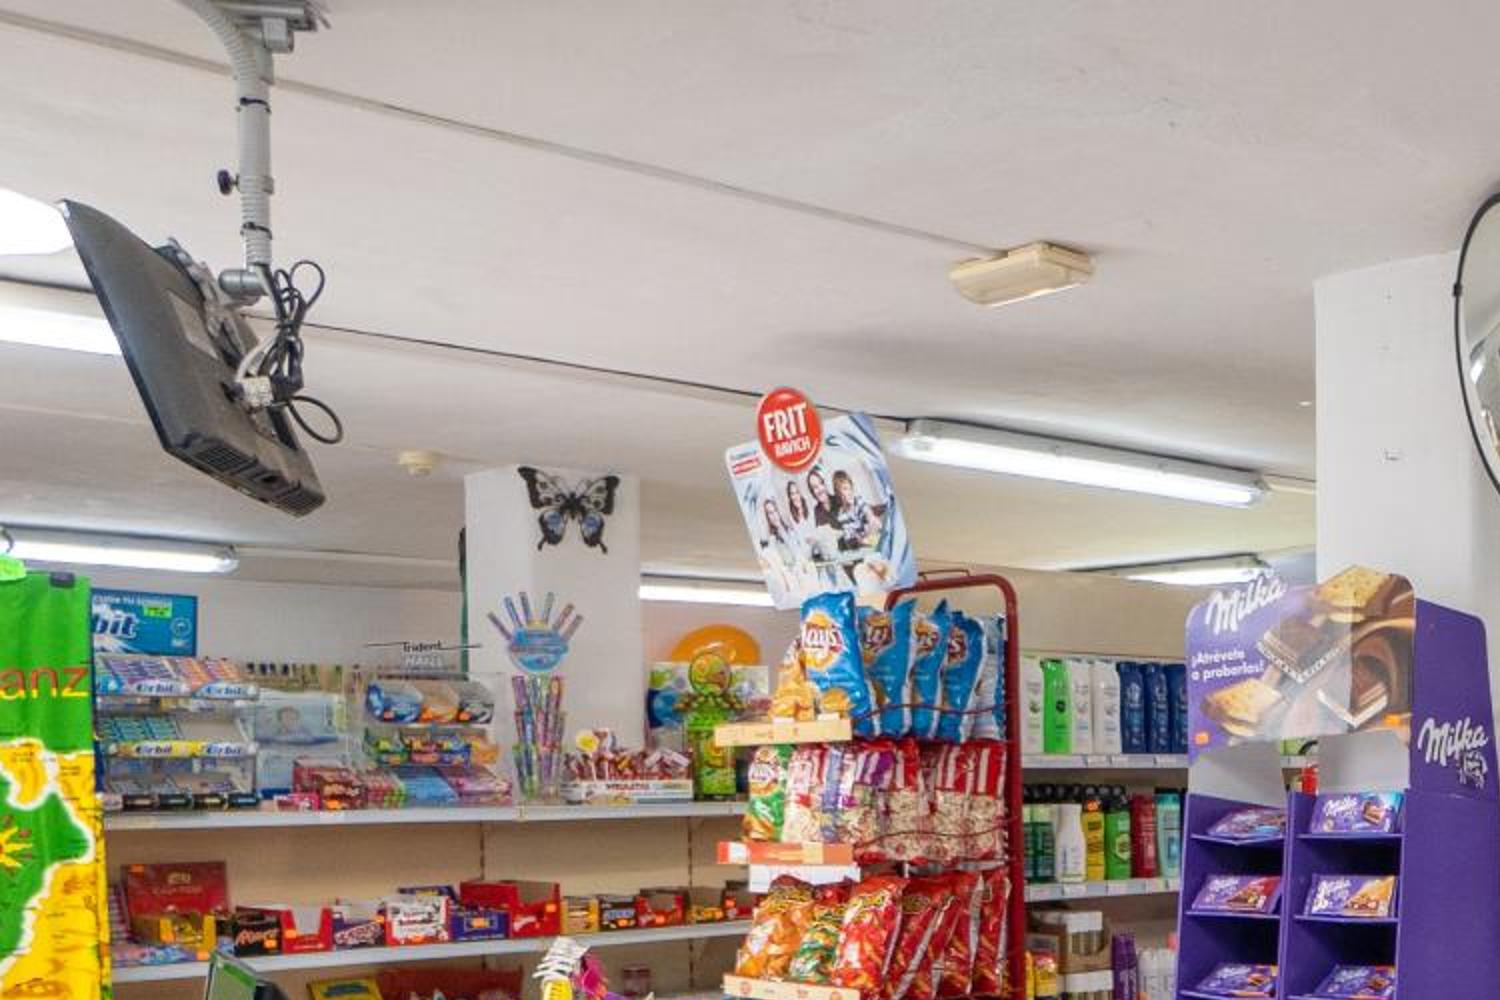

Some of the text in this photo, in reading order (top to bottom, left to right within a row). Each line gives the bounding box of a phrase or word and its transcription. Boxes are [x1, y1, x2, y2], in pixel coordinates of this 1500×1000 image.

[763, 402, 807, 443] FRIT
[1205, 569, 1286, 635] Milka
[1417, 716, 1488, 766] Milka
